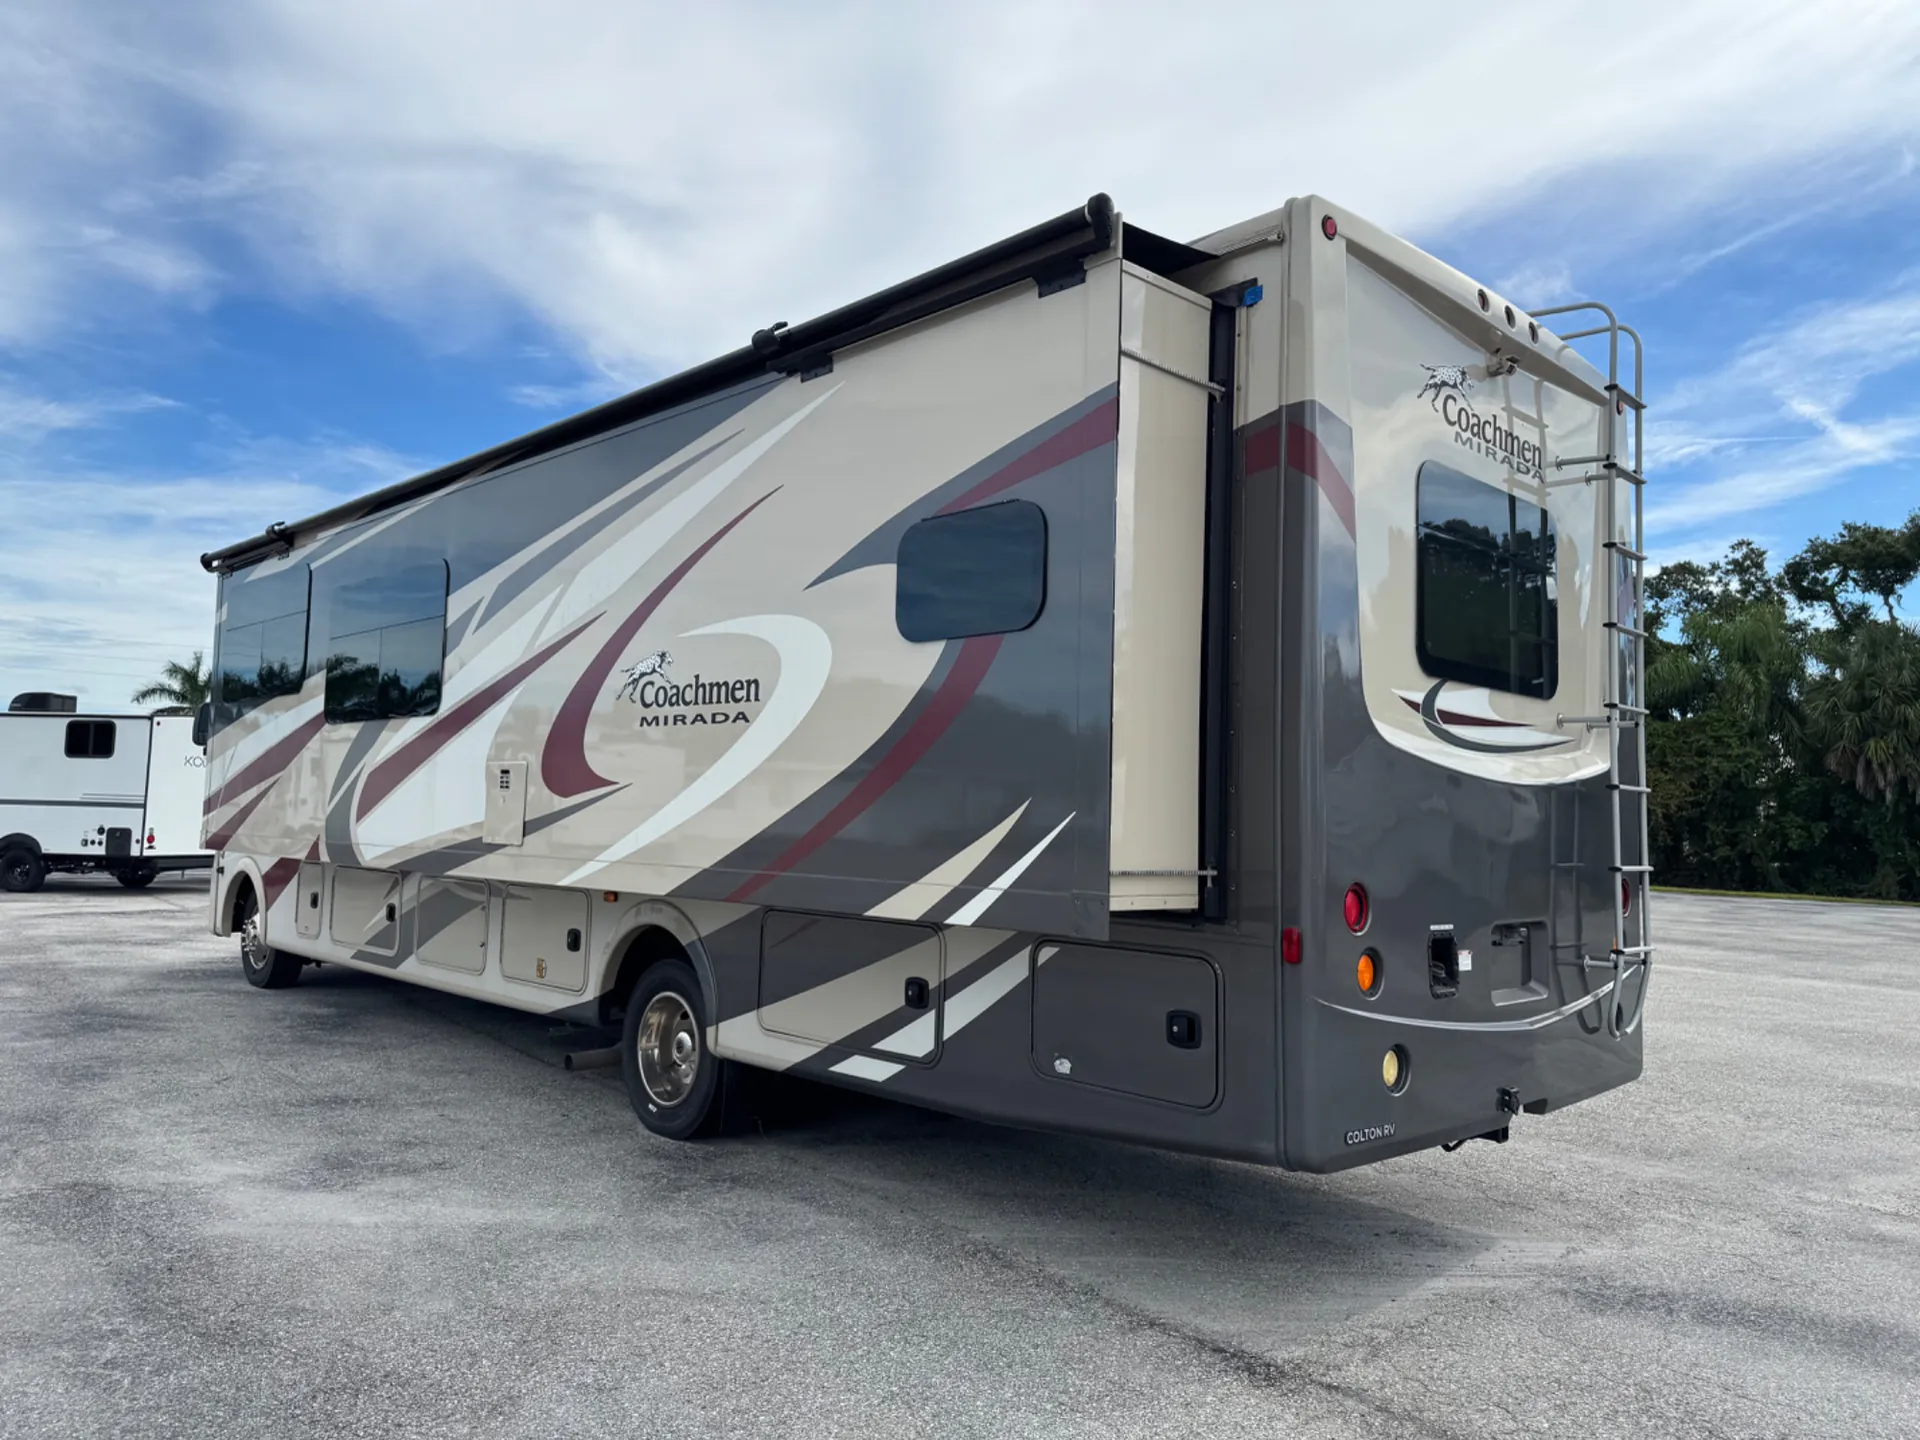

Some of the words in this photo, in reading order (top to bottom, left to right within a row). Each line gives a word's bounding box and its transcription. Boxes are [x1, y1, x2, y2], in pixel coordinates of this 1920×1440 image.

[1442, 393, 1542, 470] Coachmen
[1454, 431, 1545, 484] MIRADA
[639, 673, 761, 709] Coachmen
[639, 711, 750, 727] MIRADA
[1346, 1126, 1382, 1144] COLTON
[1383, 1122, 1396, 1137] RV
